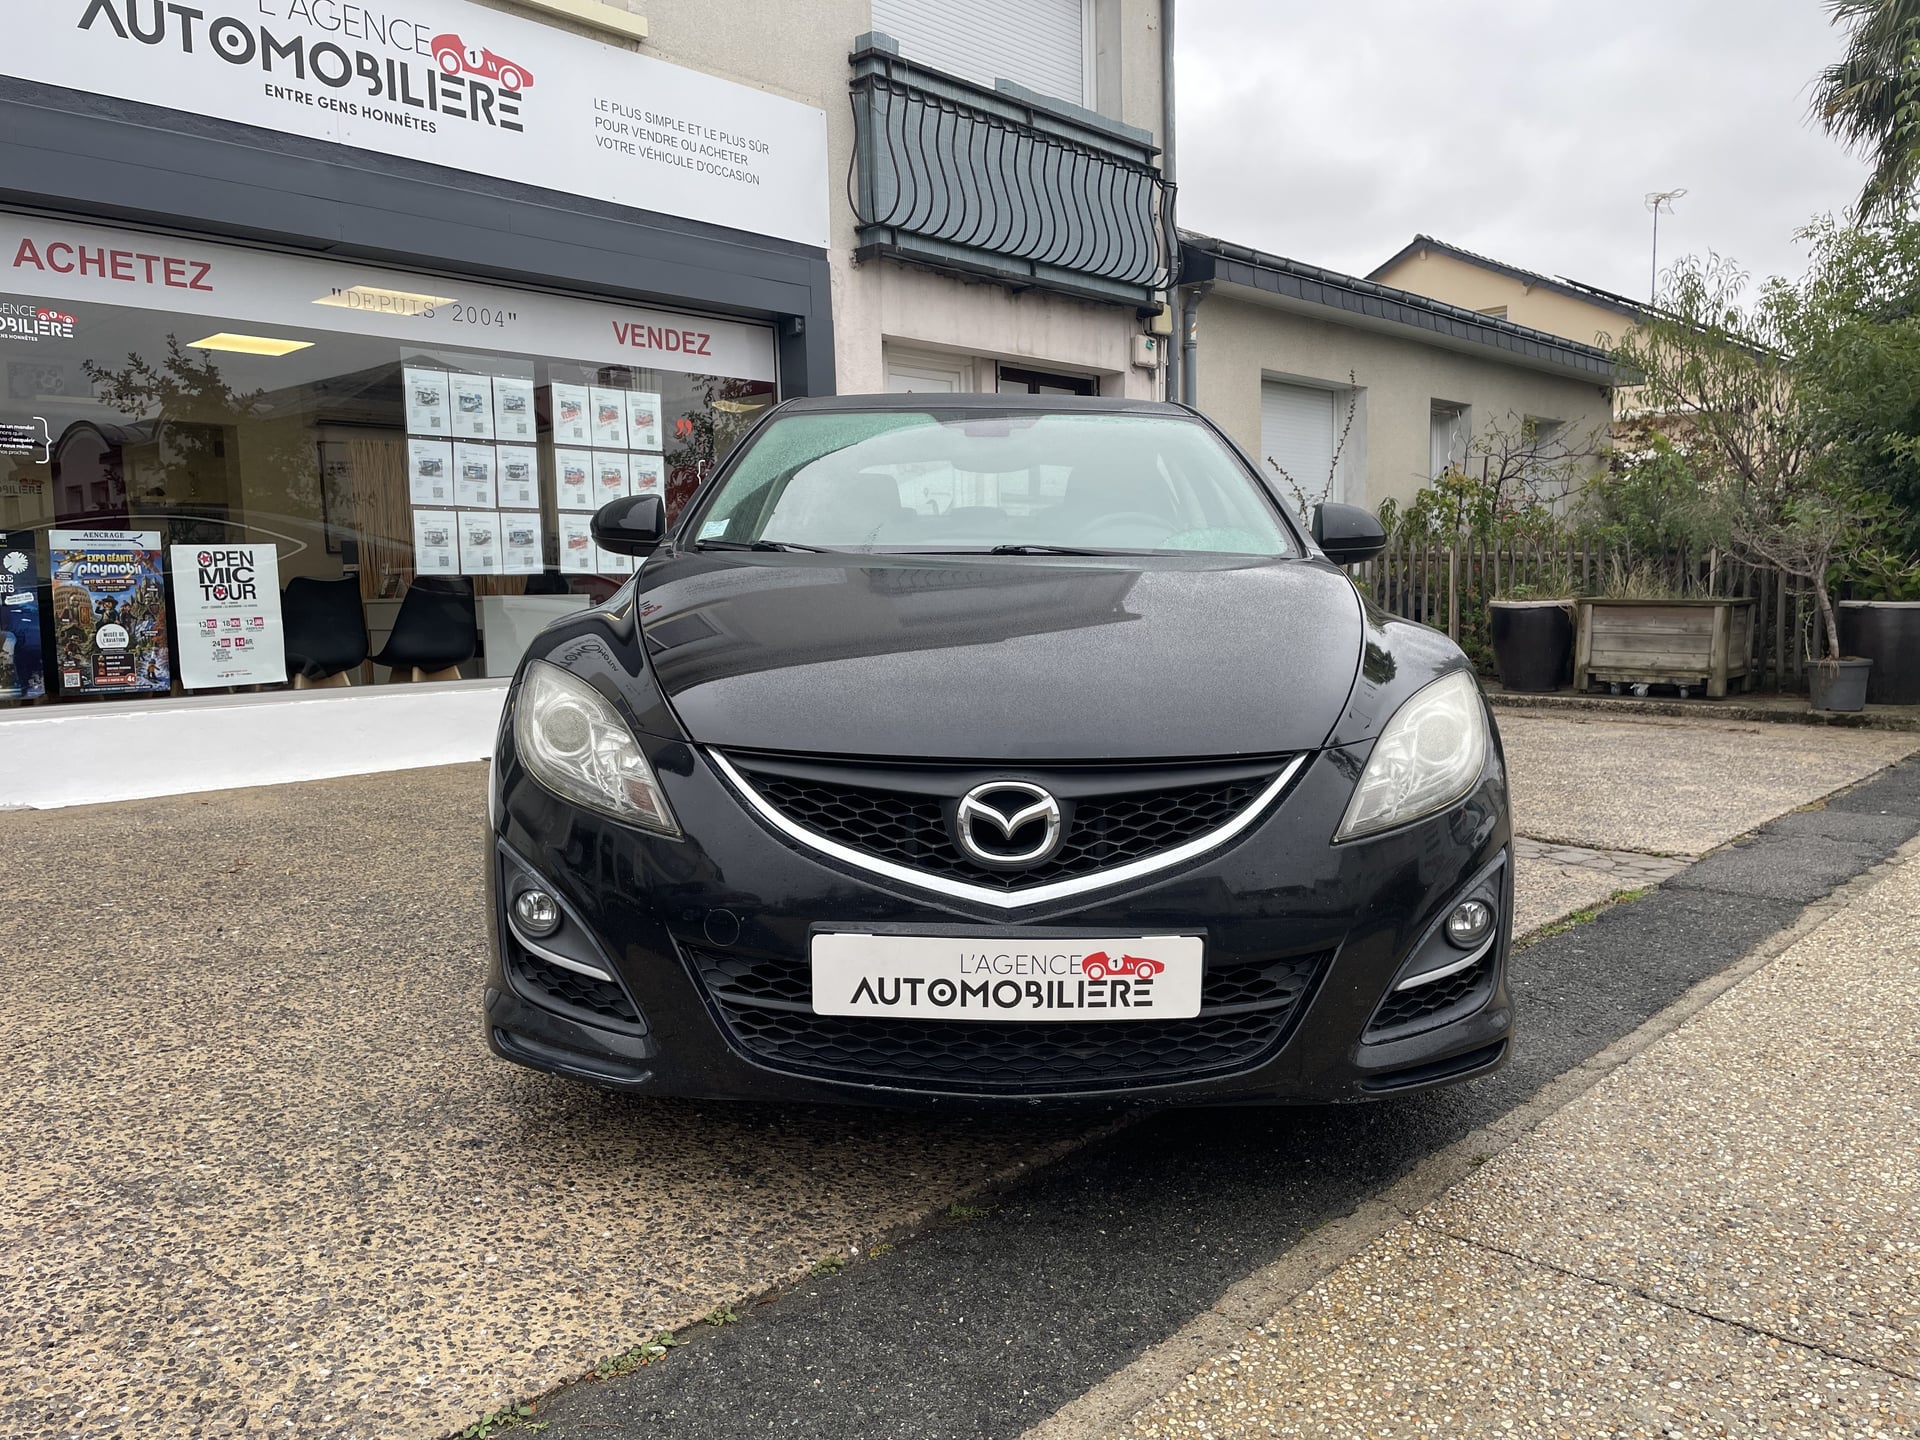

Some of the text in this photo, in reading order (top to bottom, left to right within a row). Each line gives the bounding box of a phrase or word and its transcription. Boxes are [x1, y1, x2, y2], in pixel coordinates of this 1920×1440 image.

[264, 83, 437, 134] ENTRE GENS HONNÊTES
[594, 98, 770, 155] LE PLUS SIMPLE ET LE PLUS SÛR
[595, 116, 748, 166] POUR VENDRE OU ACHETER
[595, 135, 760, 186] VOTRE VÉHICULE D'OCCASION
[13, 238, 214, 291] ACHETEZ
[612, 320, 712, 356] VENDEZ
[83, 531, 125, 539] AENCRAGE
[87, 552, 134, 563] EXPO GÉANTE
[197, 550, 254, 568] OPEN
[77, 562, 142, 577] playmobil
[199, 567, 255, 584] MIC
[199, 584, 257, 601] TOUR
[235, 638, 244, 647] 14
[960, 953, 1082, 976] L'AGENCE
[850, 976, 1154, 1009] AUTOMOBILIERE
